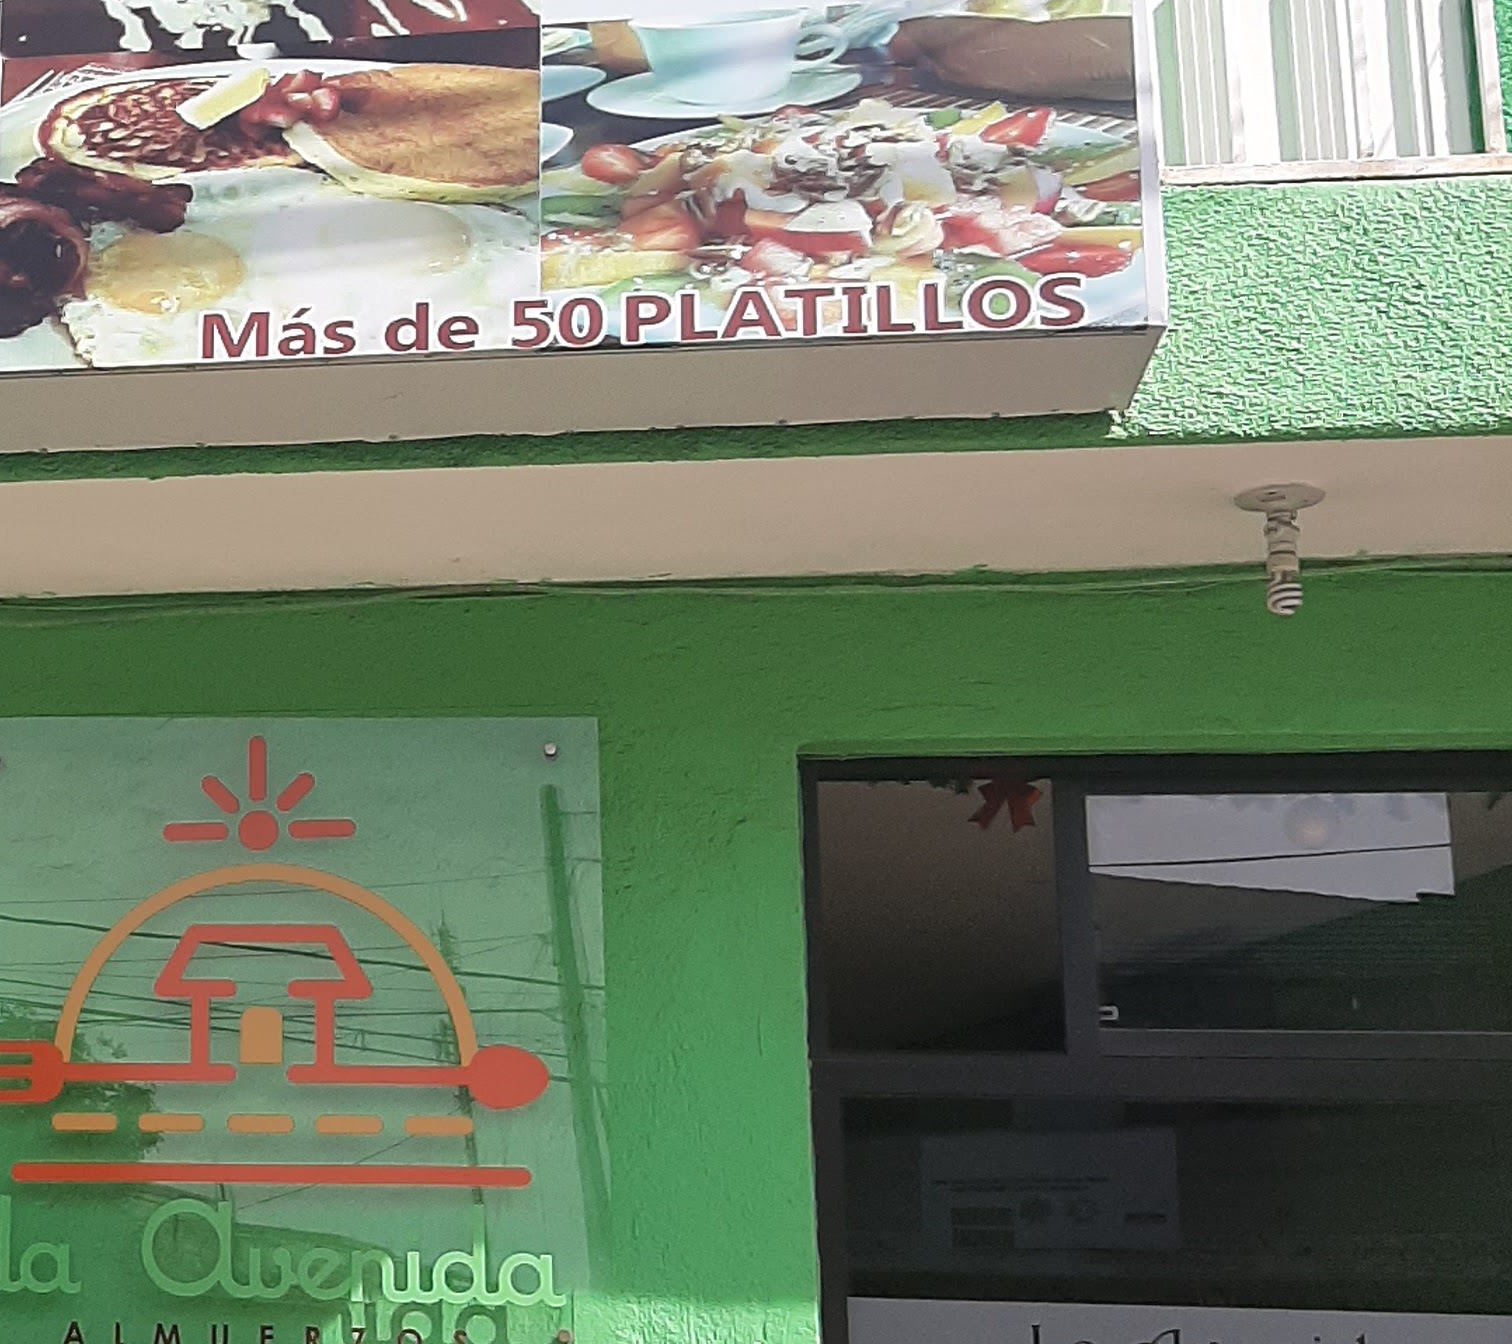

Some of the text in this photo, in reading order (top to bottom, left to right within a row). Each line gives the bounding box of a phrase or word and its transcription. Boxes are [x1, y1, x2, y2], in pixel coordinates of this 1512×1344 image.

[199, 277, 1087, 360] Más de 50 PLATILLOS
[141, 1197, 568, 1308] Avenida
